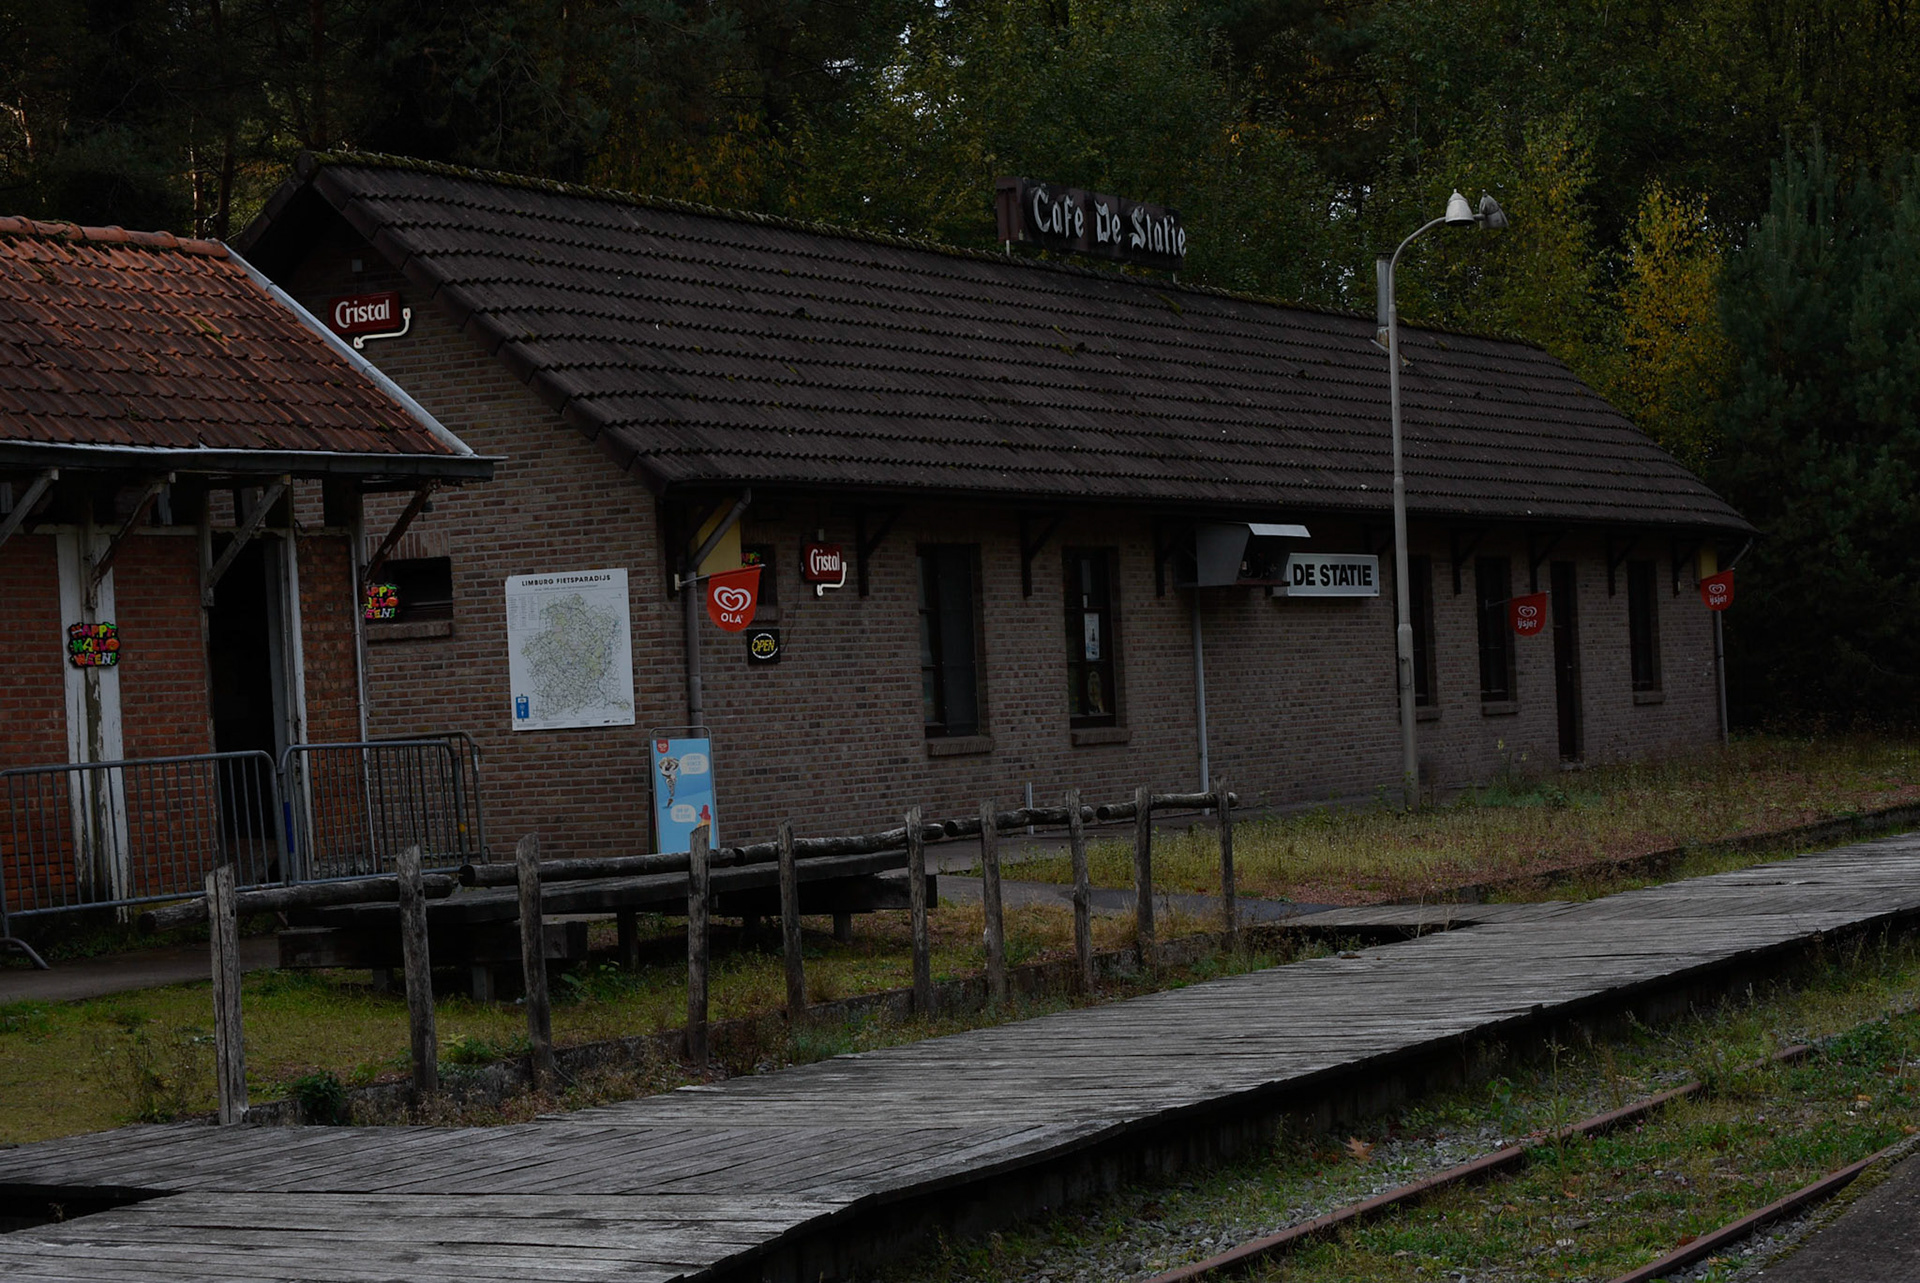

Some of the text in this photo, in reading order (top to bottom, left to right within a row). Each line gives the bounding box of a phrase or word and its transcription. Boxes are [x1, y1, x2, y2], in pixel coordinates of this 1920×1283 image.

[1031, 185, 1187, 258] Cafe De Statie
[334, 298, 391, 329] Cristal
[809, 548, 841, 576] Cristal
[521, 574, 611, 587] LIMBURG FIETSPARADIJS
[1292, 563, 1373, 587] DE STATIE
[720, 612, 742, 625] OLA
[751, 638, 776, 653] OPEN
